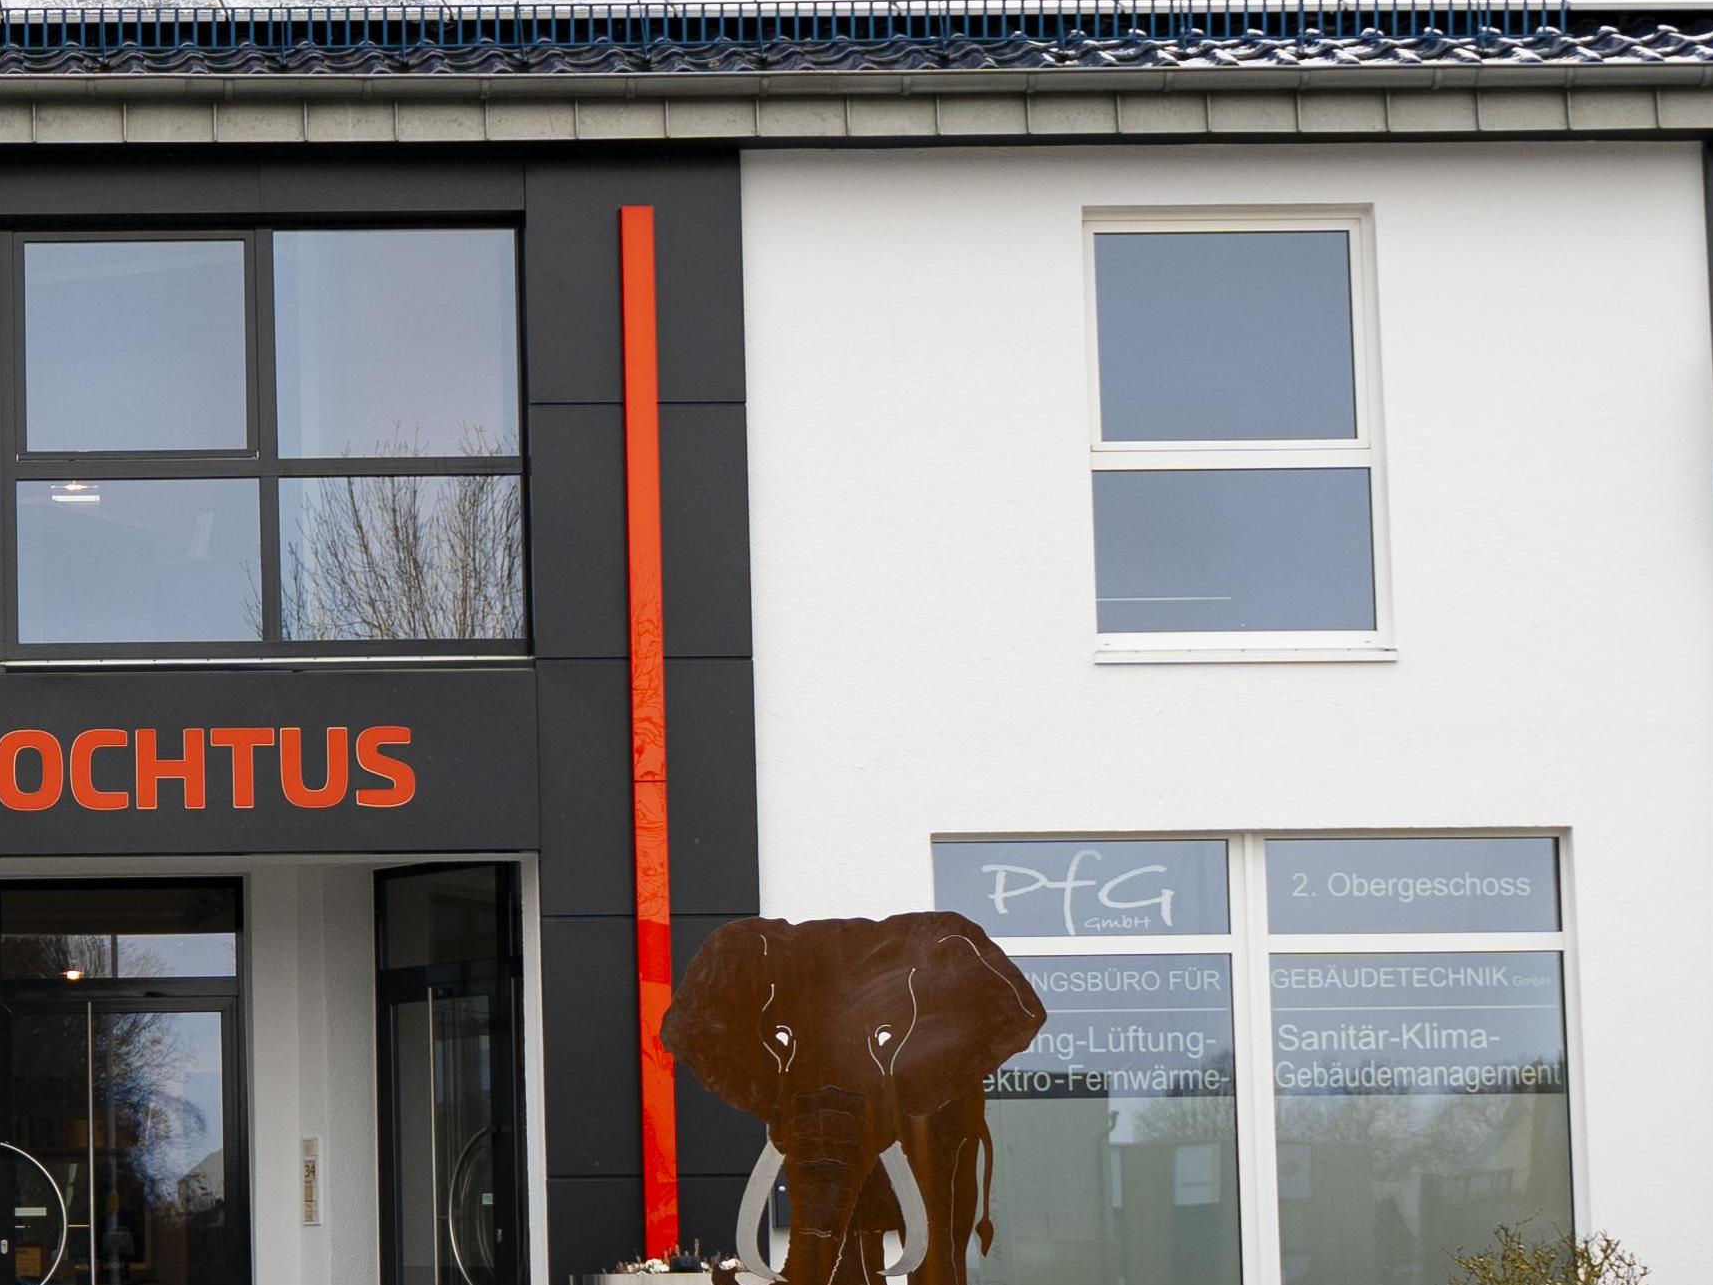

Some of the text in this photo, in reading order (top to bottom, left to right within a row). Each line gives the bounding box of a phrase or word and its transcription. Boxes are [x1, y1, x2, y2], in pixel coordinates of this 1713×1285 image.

[1291, 872, 1532, 903] 2. Obergeschoss
[1084, 915, 1152, 930] GmbH
[1024, 965, 1550, 992] NGSBÜRO FÜR GEBÄUDETECHNIK GmbH
[1029, 1022, 1501, 1060] ng-Lüftung- Sanitär-Klima-
[1275, 1061, 1562, 1092] Gebäudemanagement
